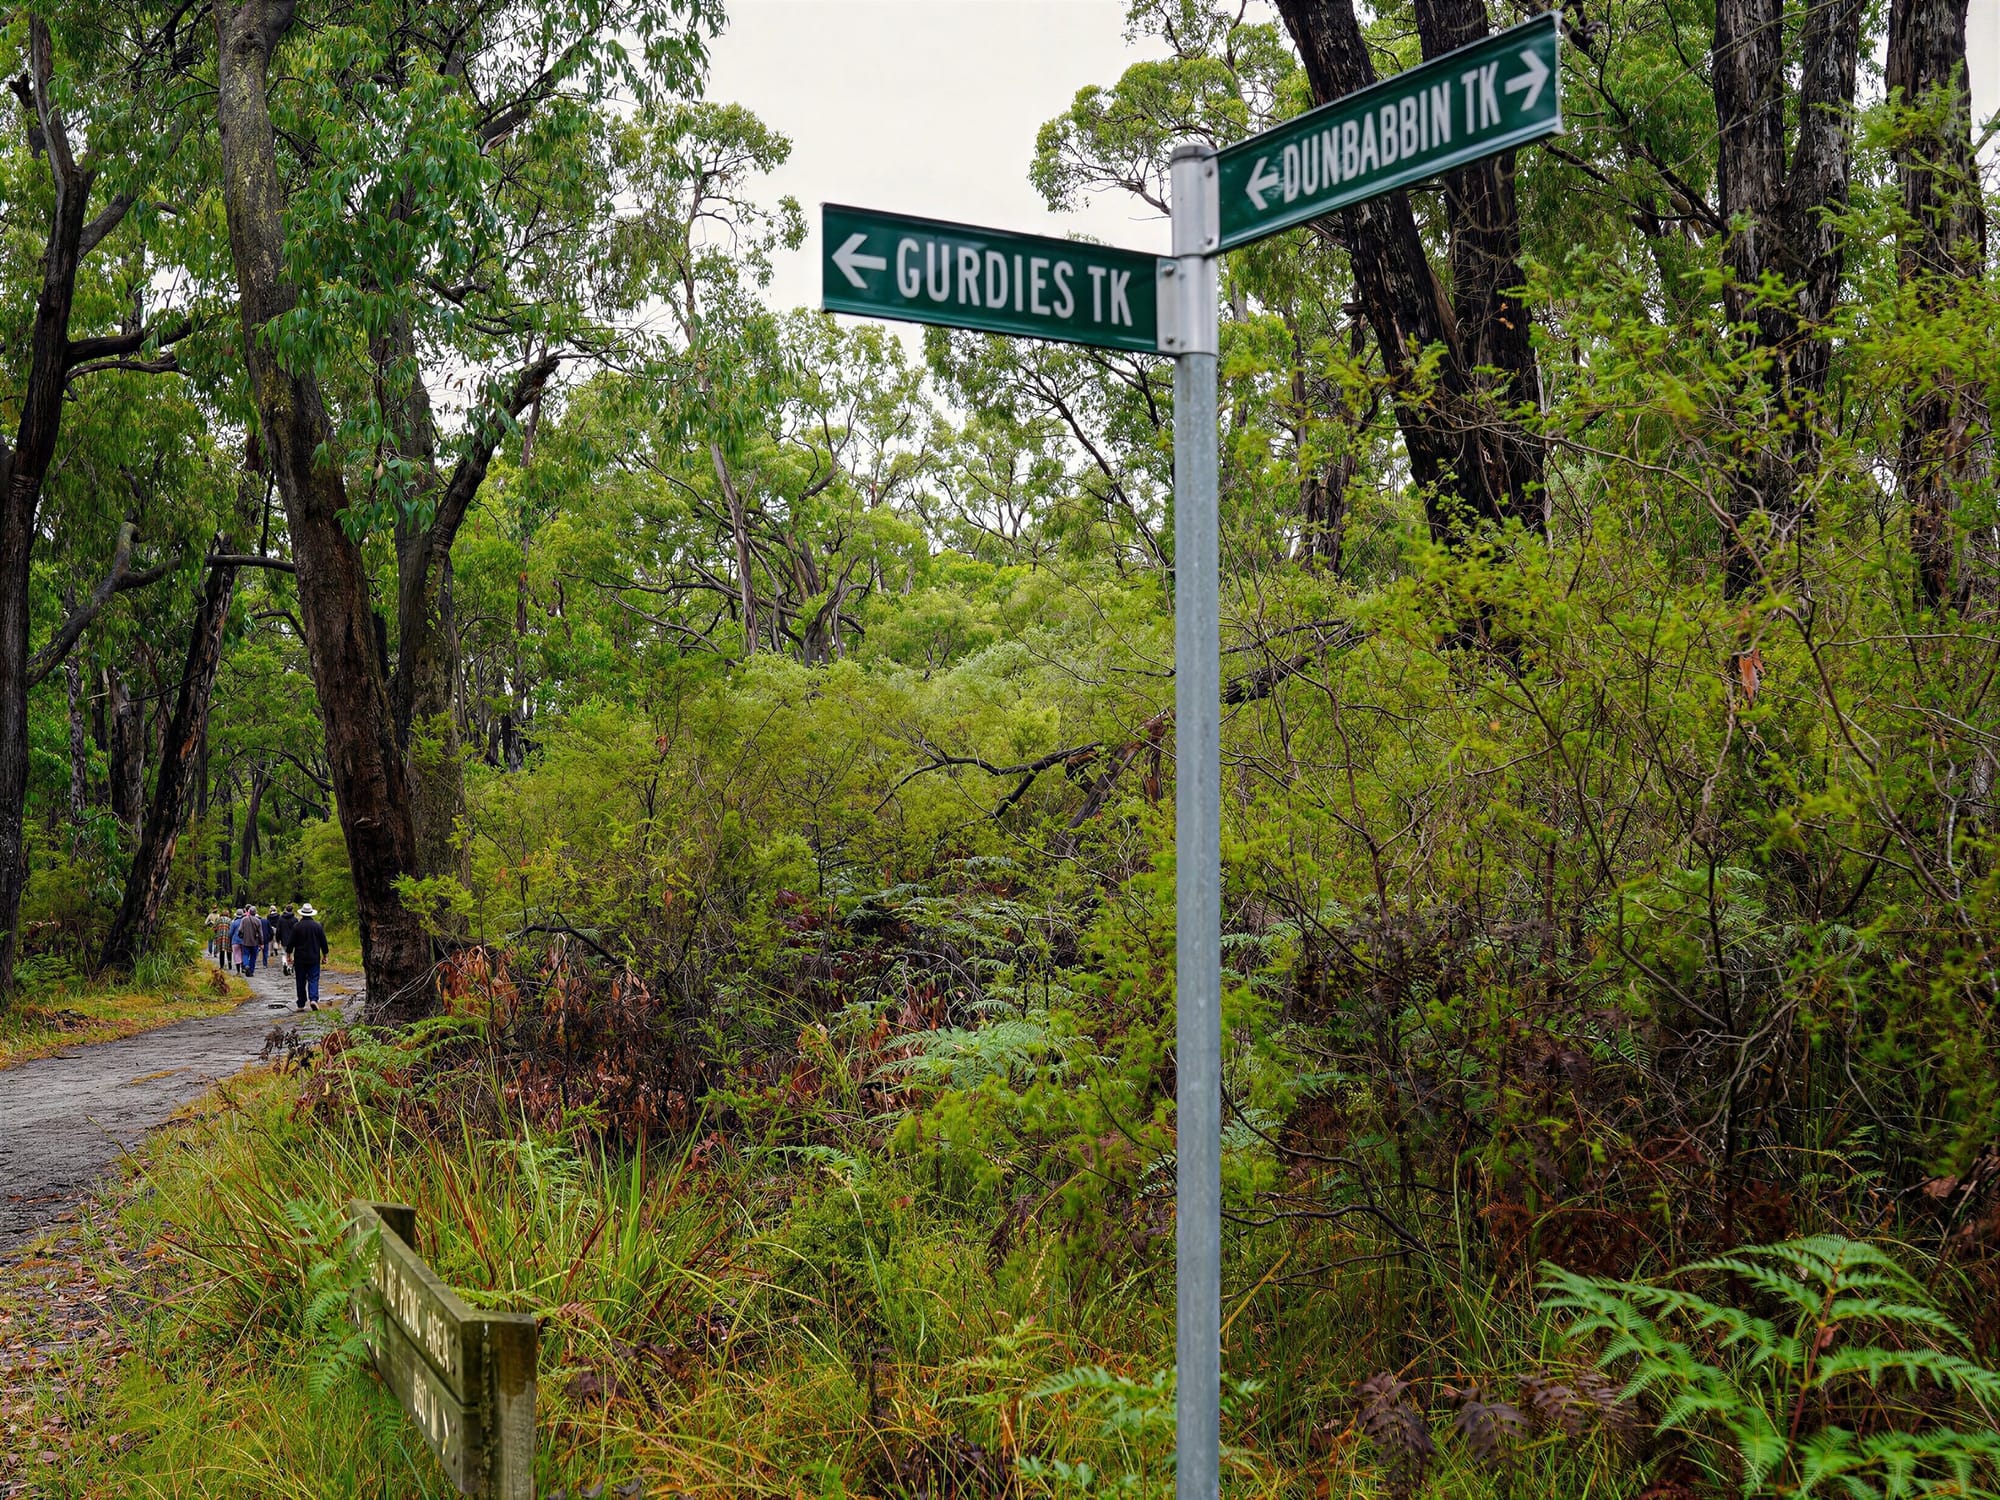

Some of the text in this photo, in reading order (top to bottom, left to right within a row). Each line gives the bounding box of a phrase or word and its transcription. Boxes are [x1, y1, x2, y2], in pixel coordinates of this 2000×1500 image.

[1282, 60, 1502, 204] DUNBABBIN TK
[895, 236, 1133, 327] GURDIES TK
[399, 1275, 422, 1339] PICNIC
[426, 1309, 450, 1373] AREA
